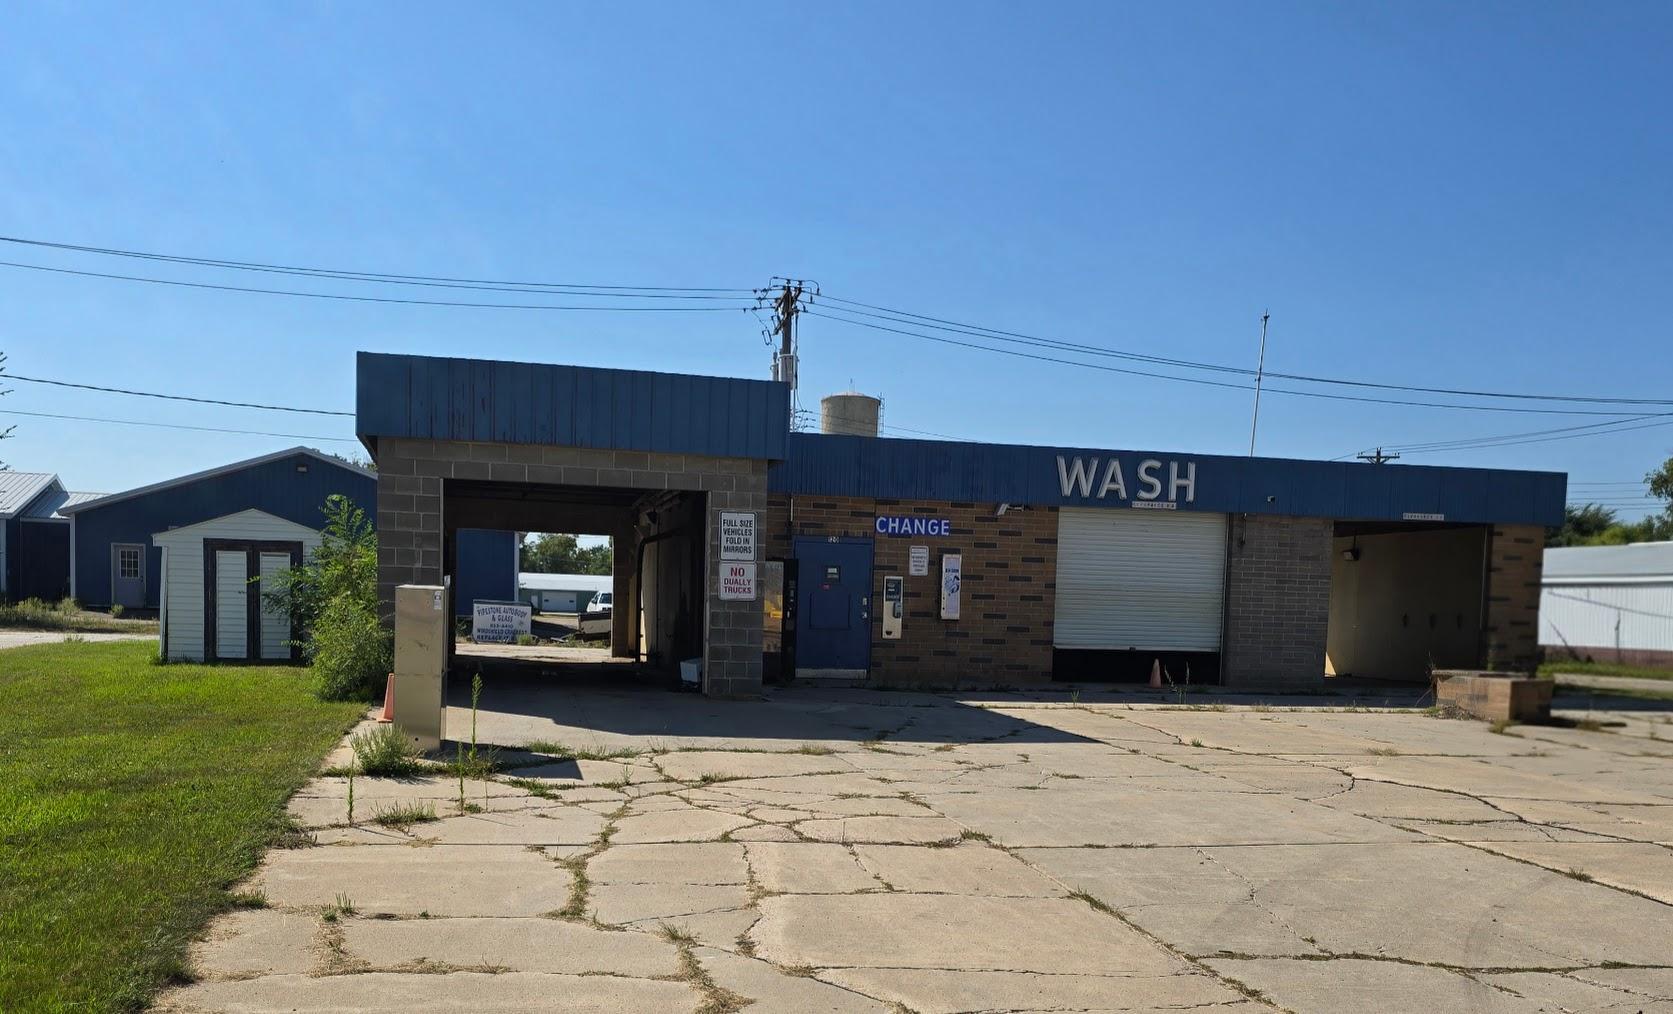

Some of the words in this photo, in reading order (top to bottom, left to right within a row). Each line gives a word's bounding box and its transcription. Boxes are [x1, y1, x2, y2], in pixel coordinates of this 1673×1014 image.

[1056, 455, 1196, 502] WASH
[723, 519, 738, 527] FULL
[739, 520, 753, 528] SIZE
[876, 516, 950, 536] CHANGE
[723, 528, 753, 536] VEHICLES
[725, 537, 742, 545] FOLD
[742, 537, 750, 545] IN
[723, 546, 752, 554] MIRRORS
[730, 567, 745, 577] NO
[723, 578, 752, 586] DUALLY
[724, 586, 752, 594] TRUCKS
[477, 606, 502, 616] PIPESTONE
[503, 607, 528, 618] AUTOBODY
[497, 614, 514, 623] GLASS
